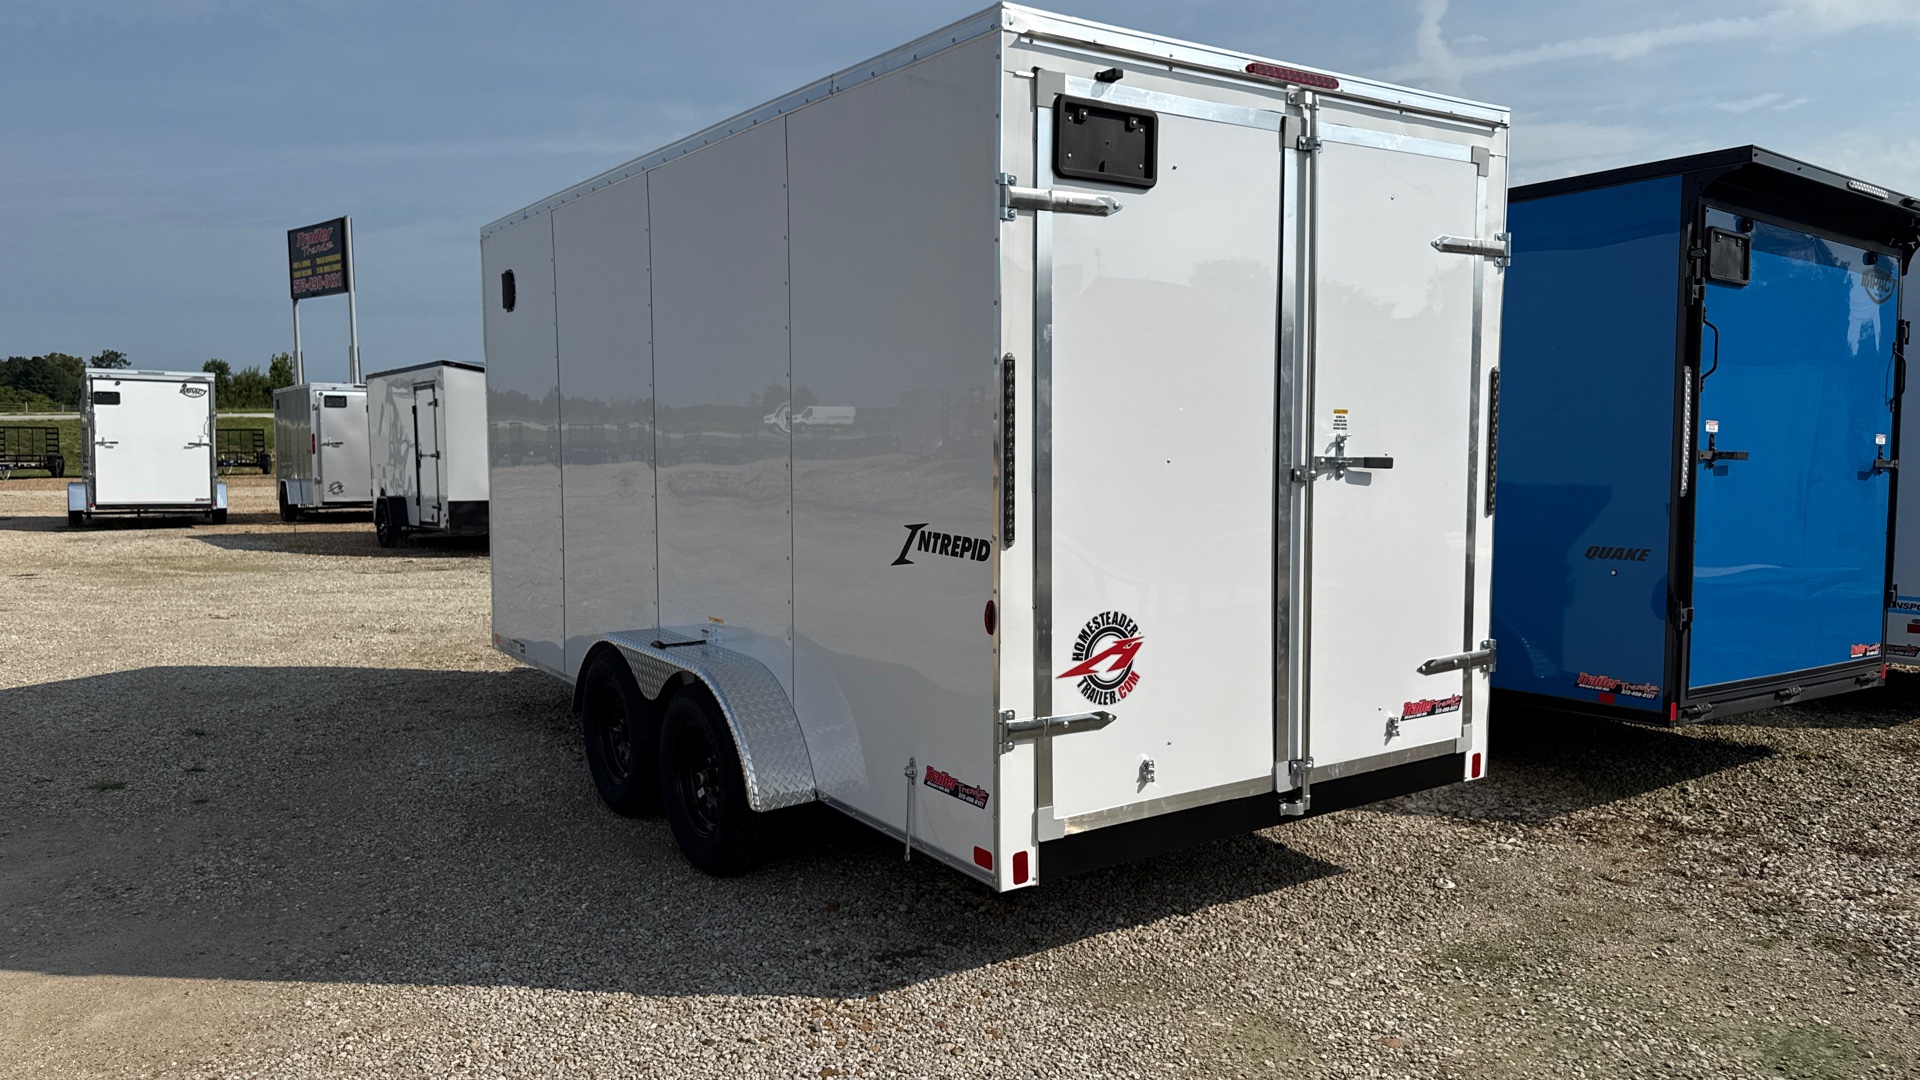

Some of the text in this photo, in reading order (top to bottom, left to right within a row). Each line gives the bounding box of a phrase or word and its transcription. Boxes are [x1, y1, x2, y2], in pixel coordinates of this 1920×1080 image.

[297, 227, 333, 247] Trailer
[891, 523, 991, 567] INTREPID
[1585, 546, 1651, 562] QUAKE
[1072, 611, 1138, 661] HOMESTEADER
[1077, 670, 1140, 705] TRAILER.COM
[1577, 672, 1620, 689] Trailer
[1403, 700, 1435, 716] Trailer
[926, 766, 958, 790] Trailer
